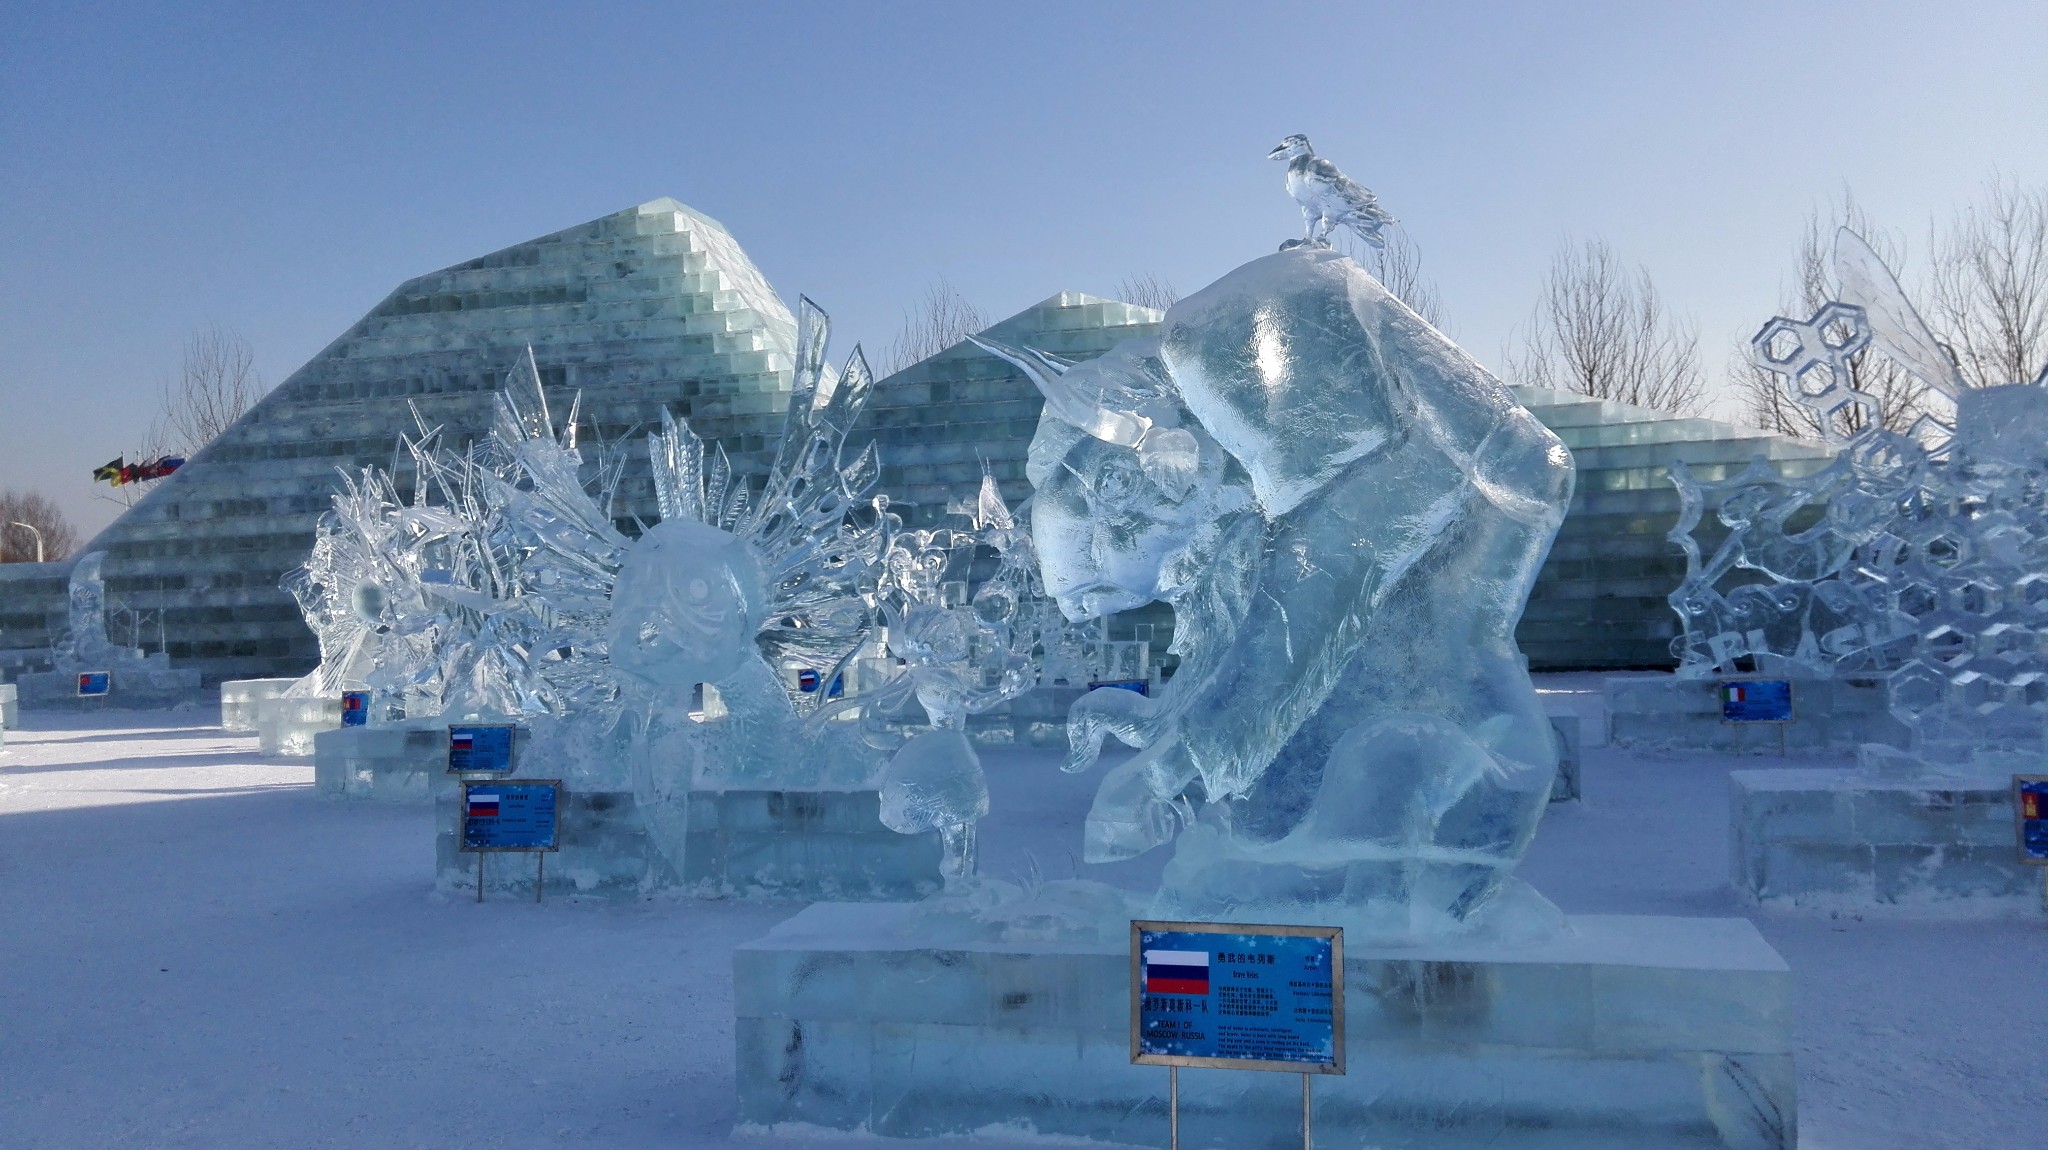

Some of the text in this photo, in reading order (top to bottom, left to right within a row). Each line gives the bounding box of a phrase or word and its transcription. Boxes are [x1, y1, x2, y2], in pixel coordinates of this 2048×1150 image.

[1158, 1020, 1175, 1028] TEAM
[1184, 1022, 1192, 1030] OF
[1147, 1030, 1205, 1040] MOSCOW RUSSIA
